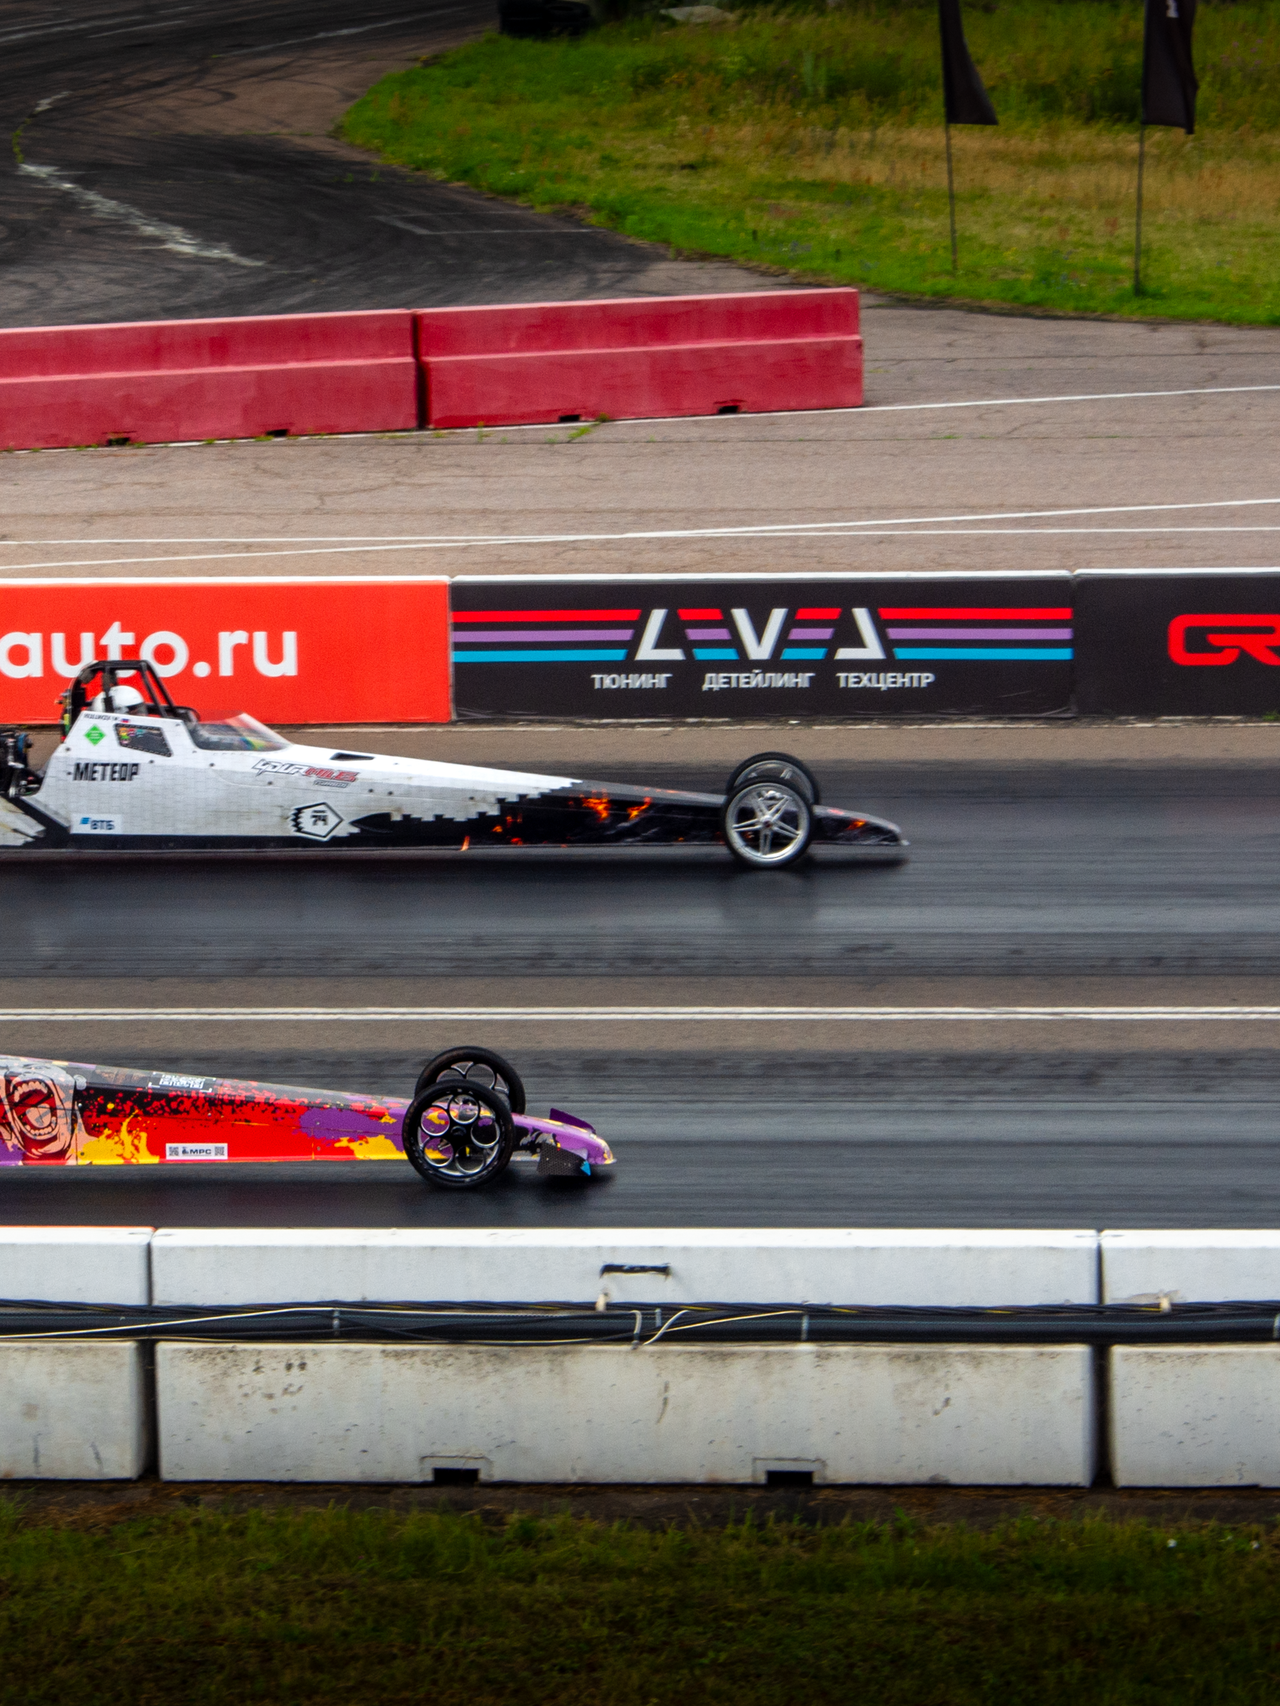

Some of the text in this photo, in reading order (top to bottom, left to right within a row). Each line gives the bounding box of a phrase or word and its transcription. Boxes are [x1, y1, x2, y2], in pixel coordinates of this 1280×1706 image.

[590, 670, 935, 692] ТЮНИНГ ДЕТЕЙЛИНГ ТЕХЦЕНТР
[73, 763, 140, 782] МЕТЕОР
[91, 819, 116, 831] ВТБ
